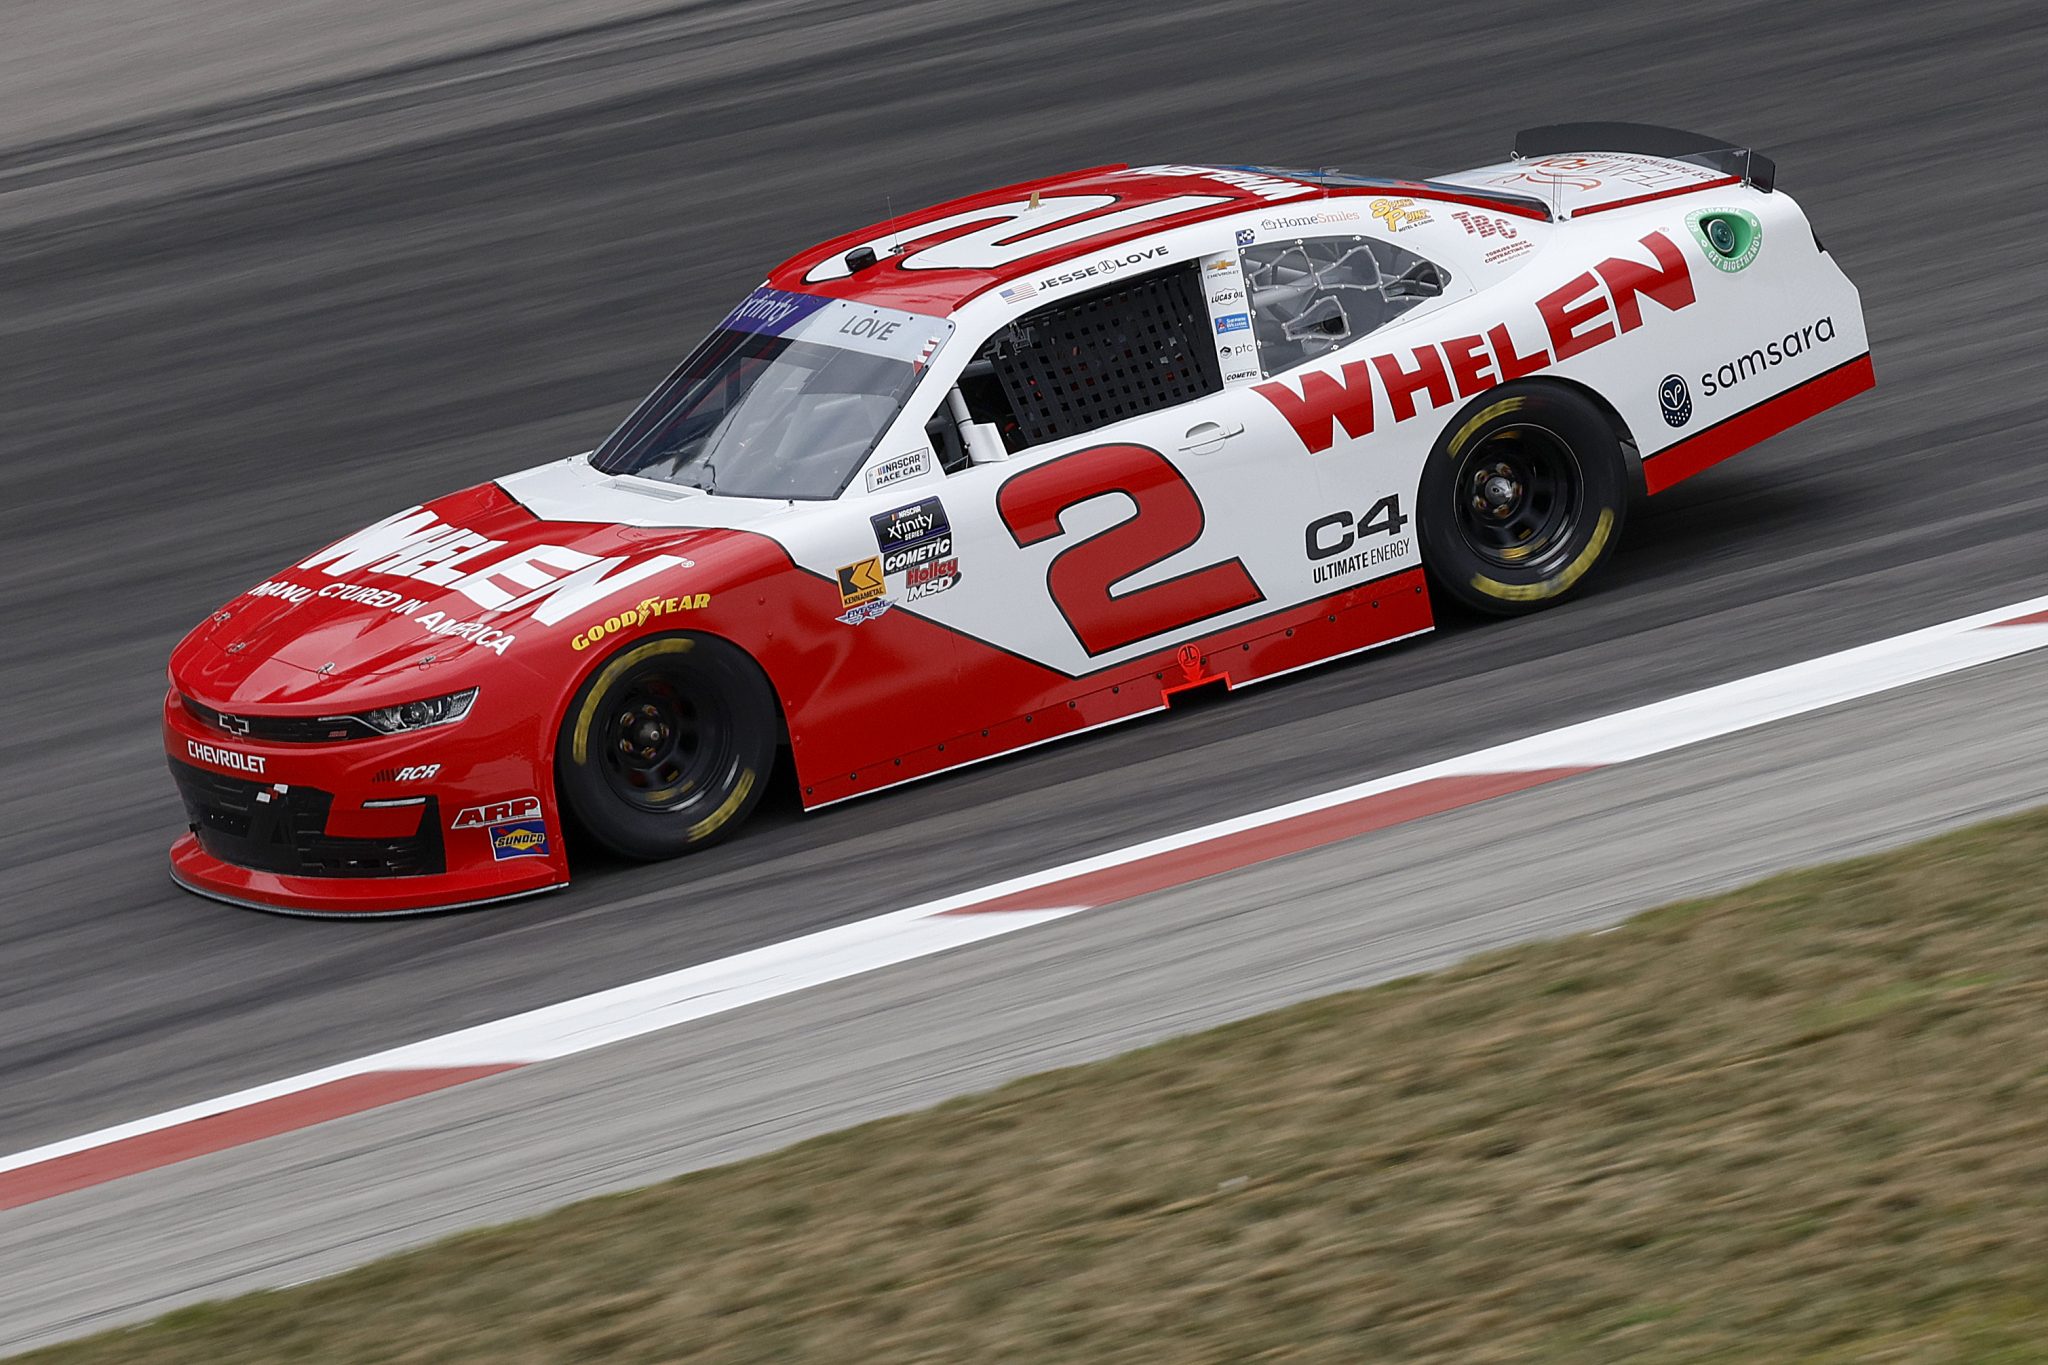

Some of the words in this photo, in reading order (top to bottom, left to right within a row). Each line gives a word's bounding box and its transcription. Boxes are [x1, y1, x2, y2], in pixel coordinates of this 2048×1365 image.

[1276, 211, 1360, 229] HomeSmiles
[1451, 211, 1517, 239] TBC
[1708, 250, 1722, 267] GET
[1722, 232, 1761, 271] BIOETHANOL
[1038, 266, 1099, 291] JESSE
[1115, 245, 1169, 268] LOVE
[1206, 269, 1239, 280] CHEVROLET
[1211, 292, 1232, 304] LUCAS
[1233, 290, 1244, 299] OIL
[839, 314, 902, 342] LOVE
[1250, 229, 1698, 455] WHELEN
[1235, 343, 1254, 356] ptc
[1700, 314, 1836, 397] samsara
[1226, 370, 1258, 381] COMETIC
[876, 470, 901, 486] RACE
[902, 464, 921, 477] CAR
[884, 453, 921, 473] NASCAR
[898, 505, 922, 518] NASCAR
[887, 513, 933, 539] xfinity
[904, 528, 924, 541] SERIES
[1305, 493, 1408, 561] C4
[885, 538, 950, 572] COMETIC
[997, 442, 1267, 658] 2
[1313, 551, 1369, 584] ULTIMATE
[1370, 538, 1410, 565] ENERGY
[297, 504, 690, 627] WHELEN
[906, 557, 958, 588] Holley
[844, 587, 884, 605] KENNAMETAL
[907, 576, 954, 602] MSD
[390, 598, 429, 616] IN
[414, 611, 516, 656] AMERICA
[188, 740, 266, 774] CHEVROLET
[395, 763, 441, 782] RCR
[453, 798, 540, 828] ARP
[497, 833, 545, 849] SUNOCO
